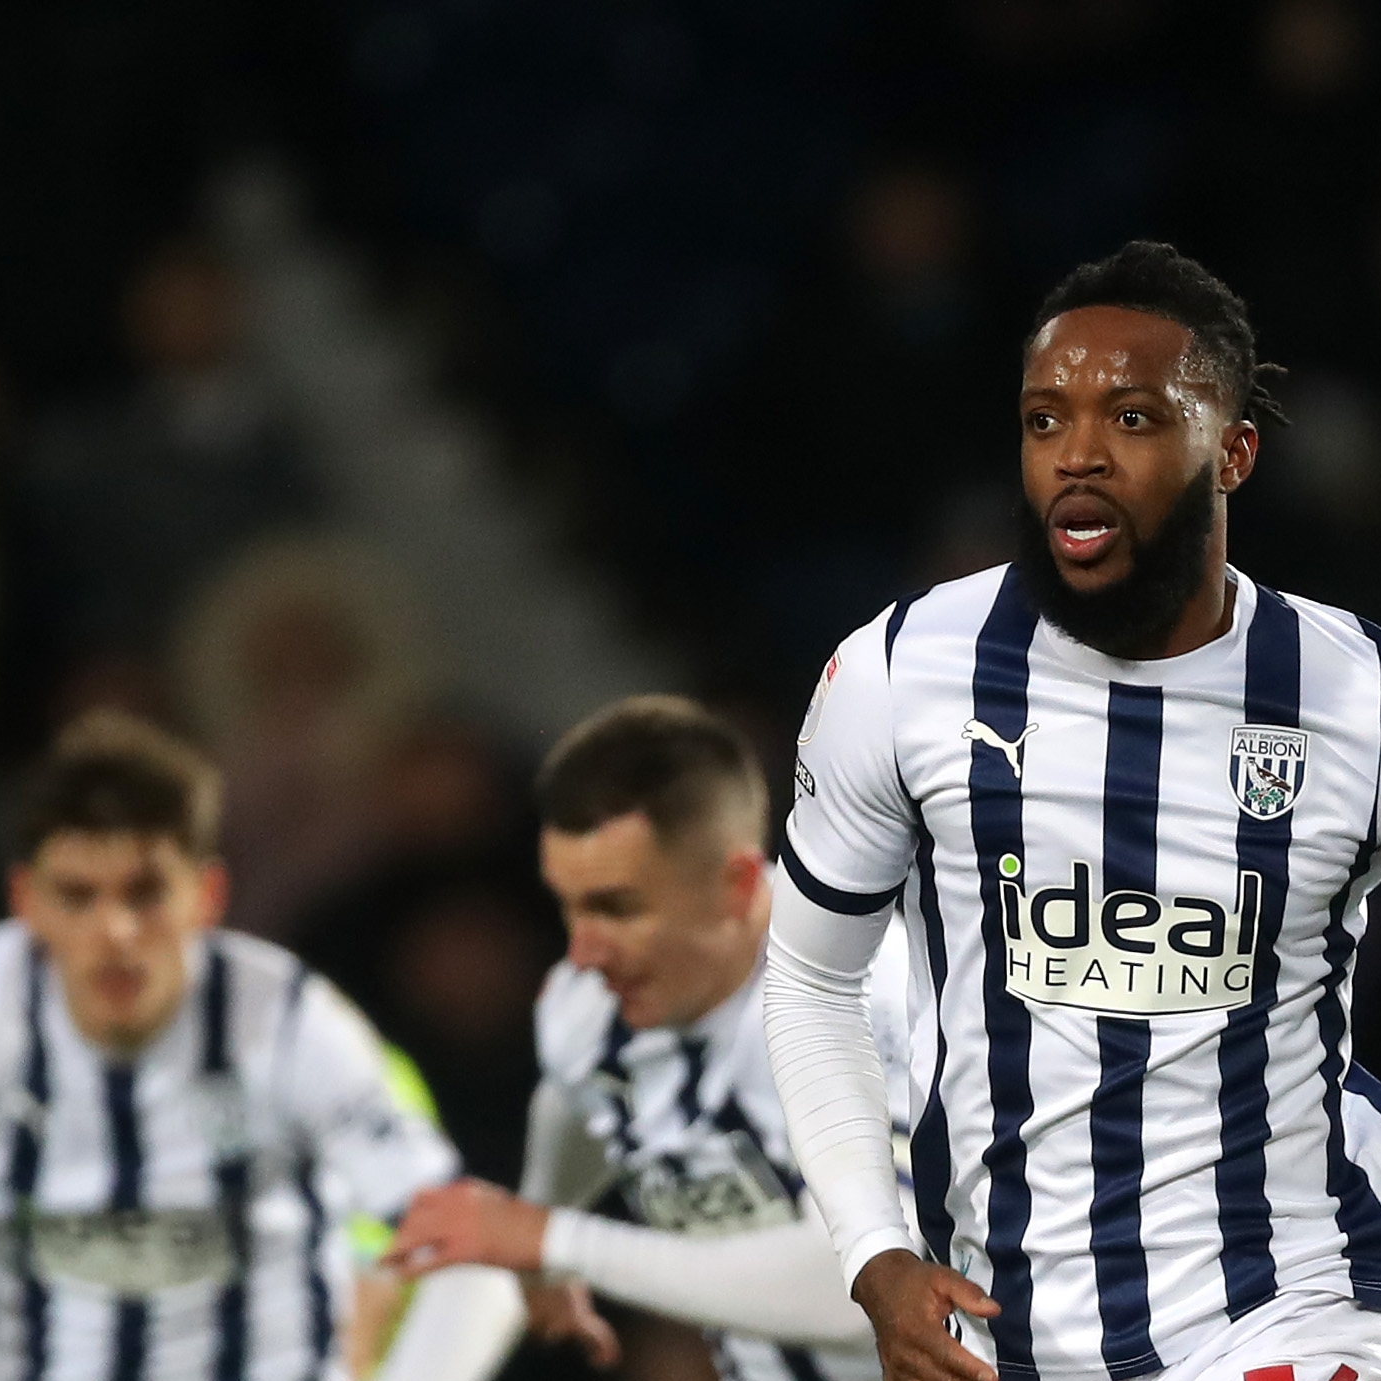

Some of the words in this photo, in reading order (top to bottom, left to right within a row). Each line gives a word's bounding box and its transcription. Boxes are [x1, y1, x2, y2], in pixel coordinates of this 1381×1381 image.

[1235, 738, 1302, 758] ALBION
[1000, 854, 1261, 958] ideal
[1009, 947, 1251, 996] HEATING
